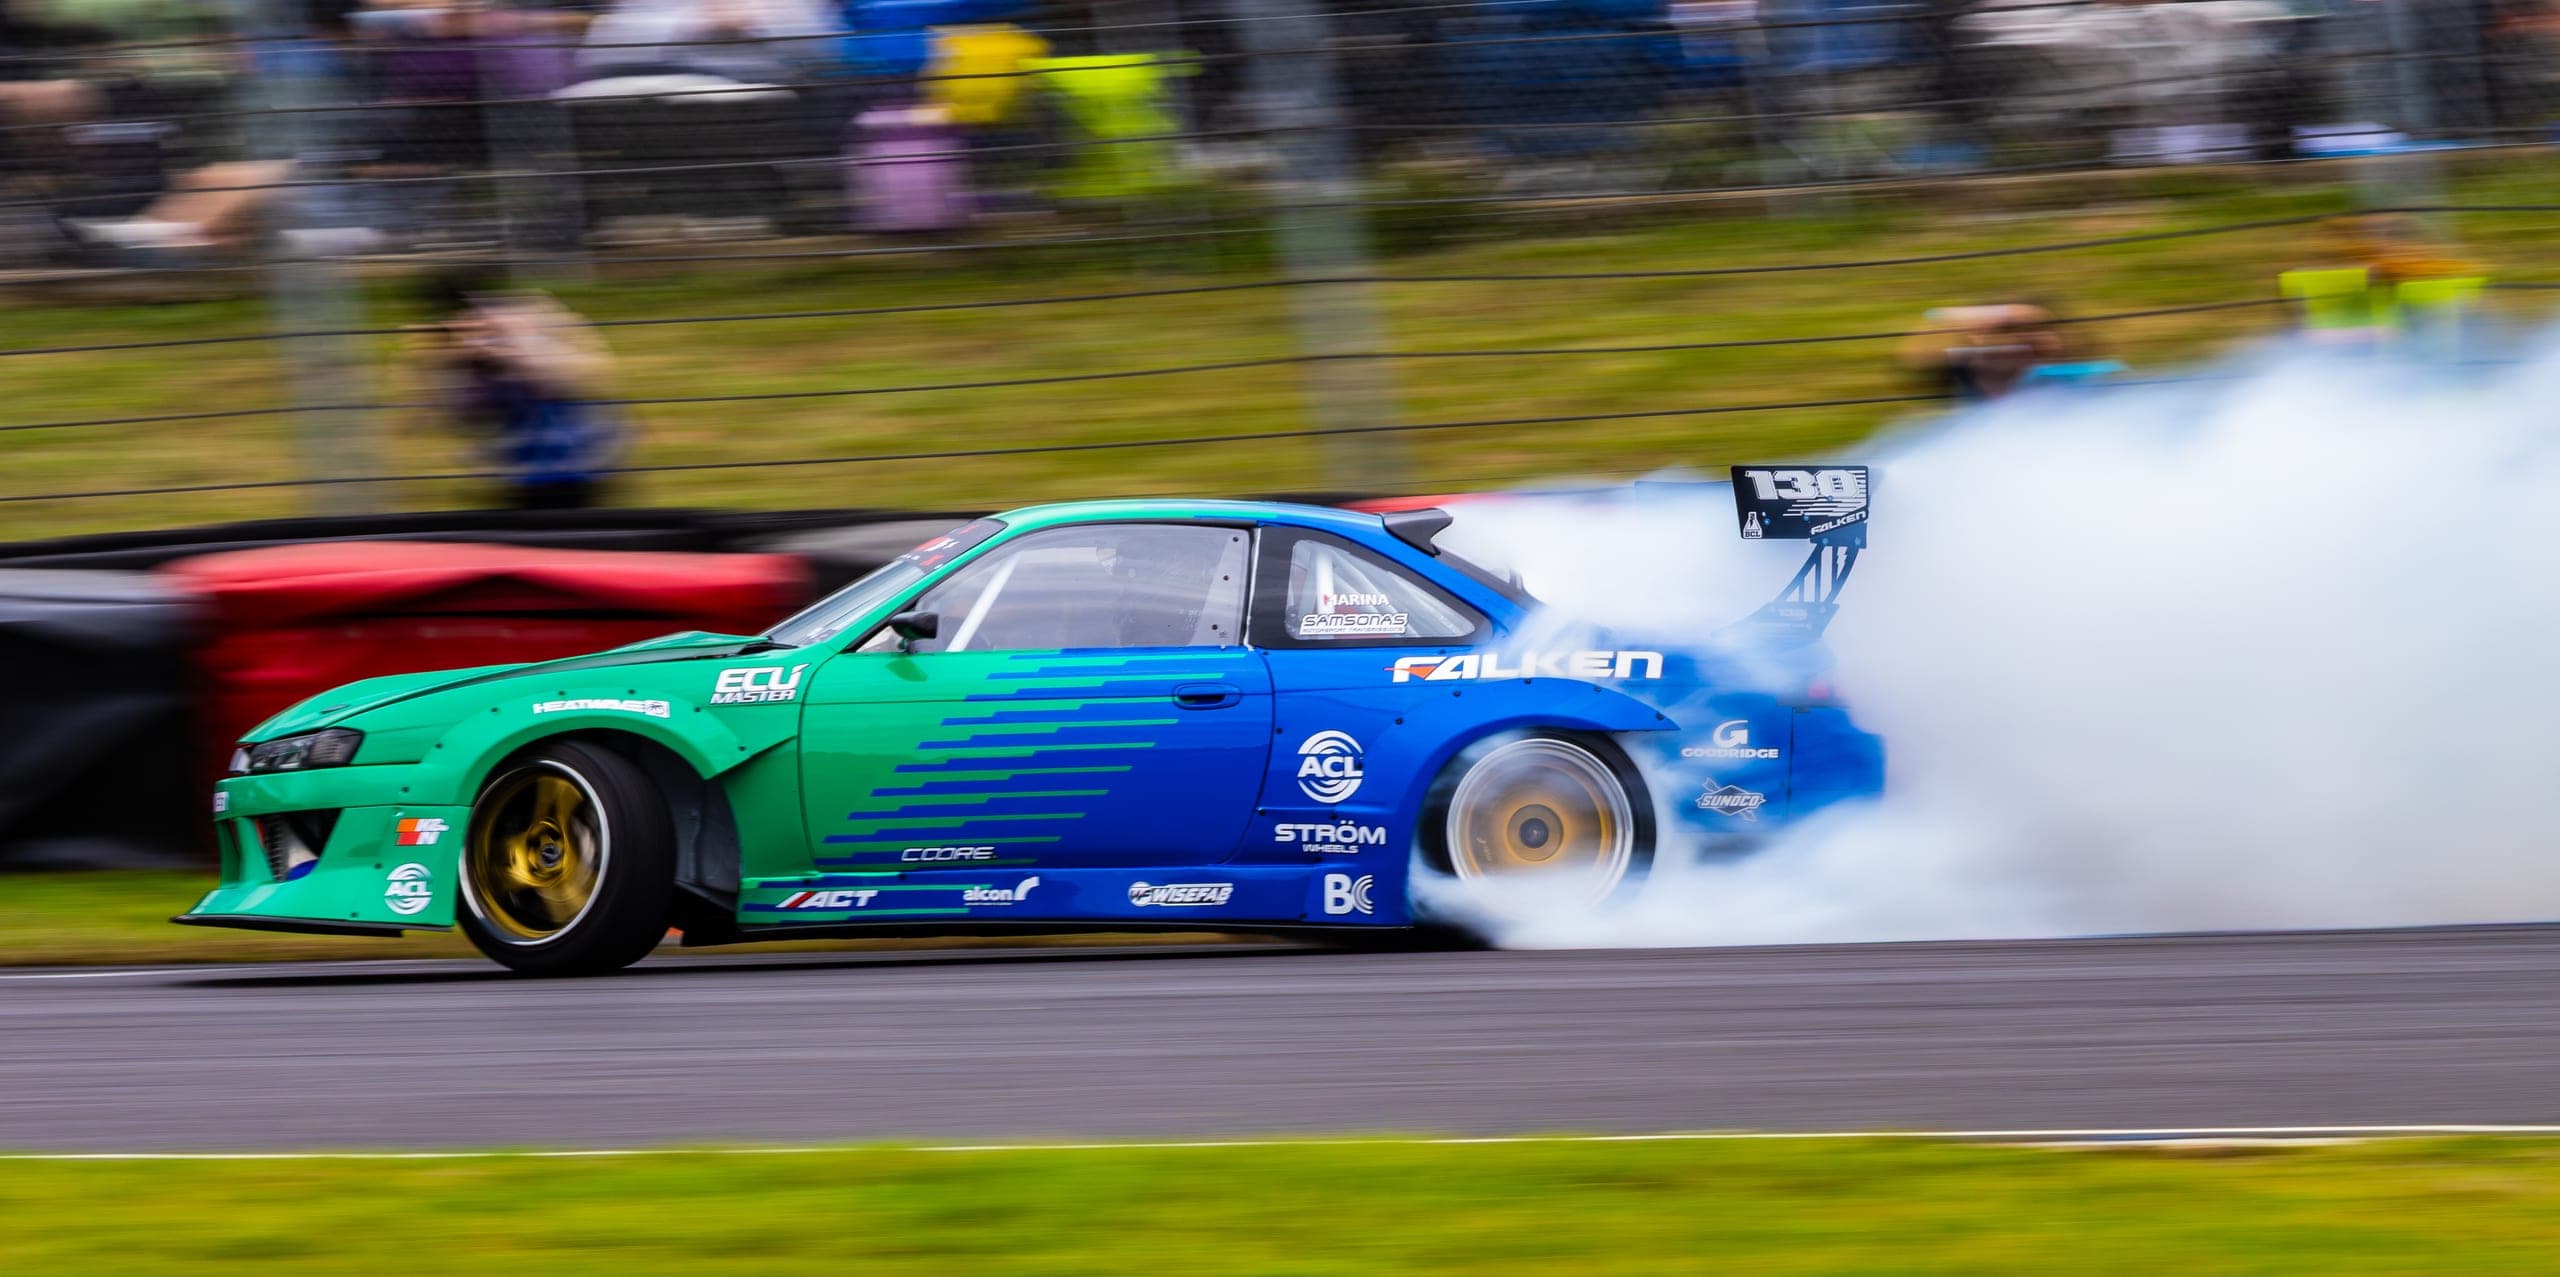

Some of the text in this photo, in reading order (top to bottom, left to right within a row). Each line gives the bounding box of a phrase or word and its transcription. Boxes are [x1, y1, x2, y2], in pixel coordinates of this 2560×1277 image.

[1744, 470, 1858, 500] 130
[1810, 510, 1865, 535] FALKEN
[1302, 614, 1406, 627] SAMSONAS
[1392, 651, 1663, 682] FALKEN
[715, 664, 809, 692] ECU
[710, 689, 796, 704] MASTER
[1680, 748, 1780, 758] GOODRIDGE
[1297, 756, 1363, 778] ACL
[1701, 795, 1761, 807] SUNOCO
[1274, 820, 1386, 845] STRÖM
[1302, 844, 1359, 853] WHEELS
[384, 880, 432, 896] ACL
[963, 886, 1013, 901] alcon
[1151, 887, 1234, 903] WISEFAB
[805, 890, 878, 908] ACT
